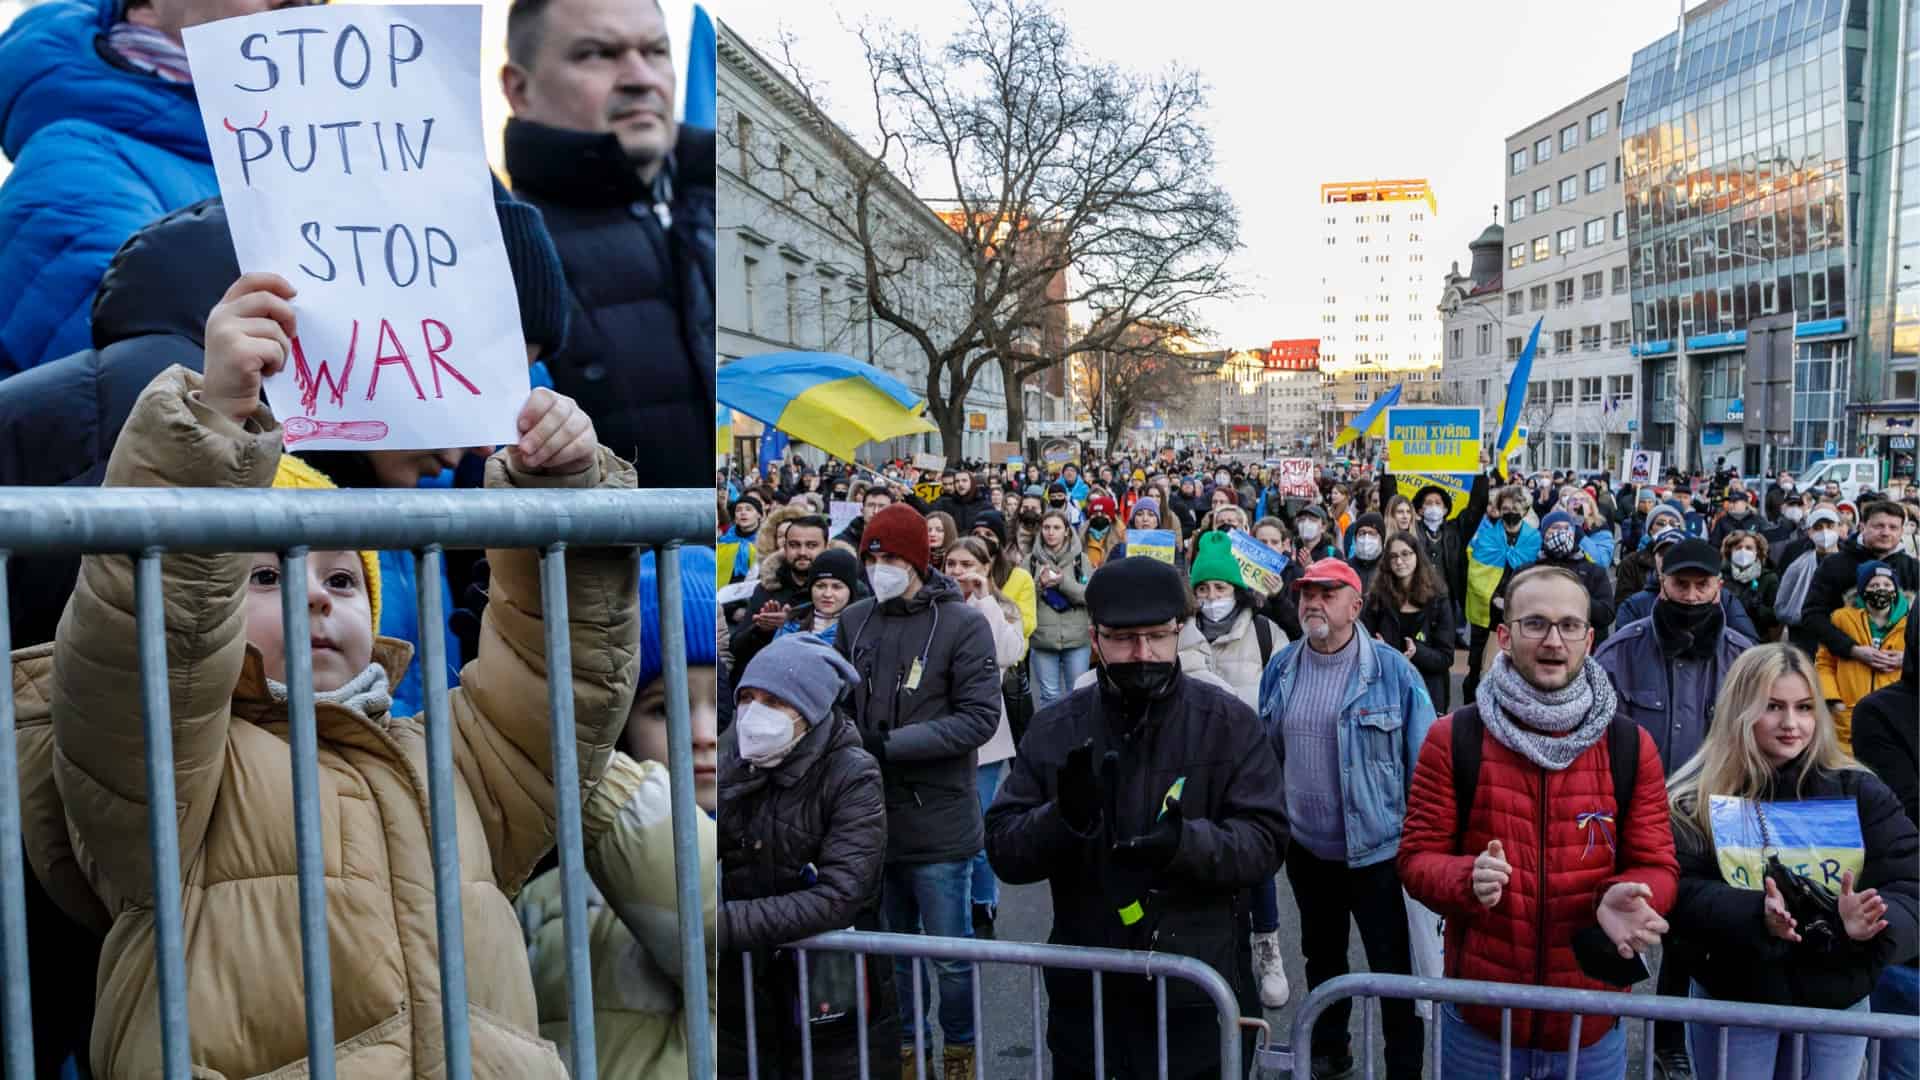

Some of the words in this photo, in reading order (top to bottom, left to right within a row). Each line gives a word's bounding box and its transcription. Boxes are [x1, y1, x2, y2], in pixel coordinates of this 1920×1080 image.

[233, 23, 424, 92] STOP
[236, 117, 435, 186] PUTIN
[299, 221, 458, 288] STOP
[291, 318, 481, 416] WAR
[1394, 425, 1428, 440] PUTIN
[1403, 440, 1432, 455] BACK
[1282, 460, 1312, 475] STOP
